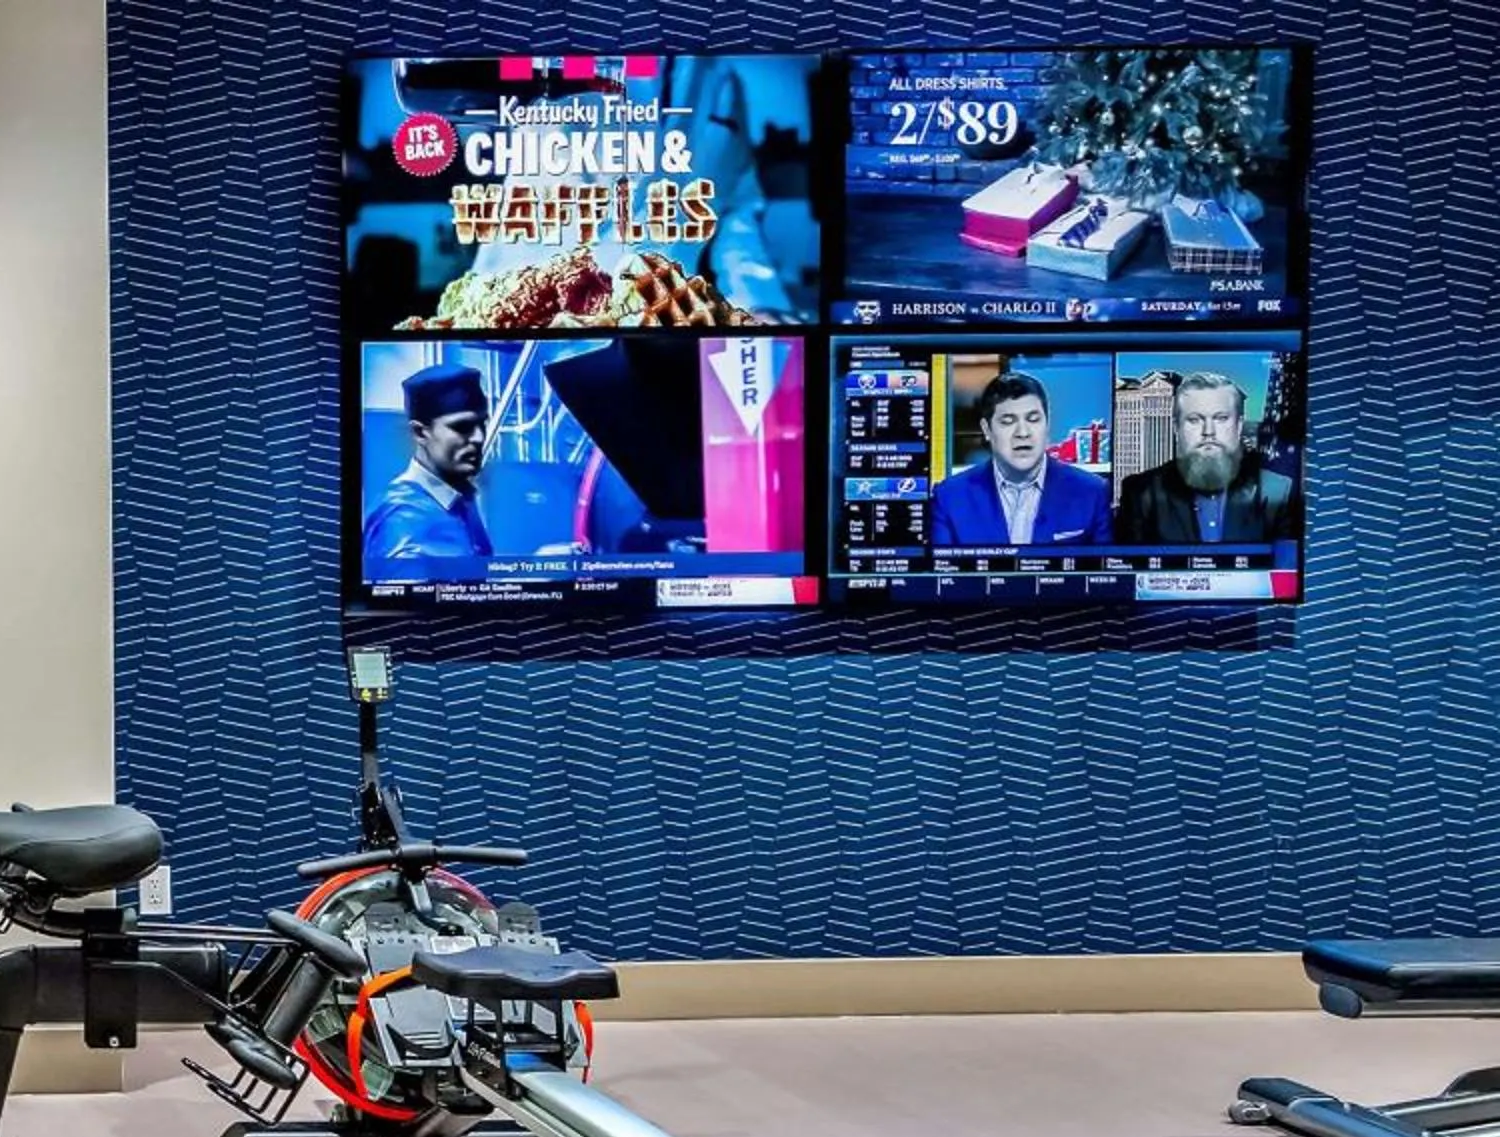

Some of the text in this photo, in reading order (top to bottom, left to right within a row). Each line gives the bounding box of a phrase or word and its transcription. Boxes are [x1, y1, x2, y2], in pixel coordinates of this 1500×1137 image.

[889, 77, 913, 91] ALL
[915, 76, 957, 91] DRESS
[500, 96, 659, 127] Kentucky Fried
[408, 124, 439, 142] IT'S
[404, 140, 445, 161] BACK
[465, 130, 693, 175] CHICKEN &
[451, 177, 718, 245] WAFFLES
[892, 303, 966, 315] HARRISON
[982, 302, 1042, 315] CHARLO
[1045, 302, 1056, 314] II
[1257, 299, 1281, 312] FOX
